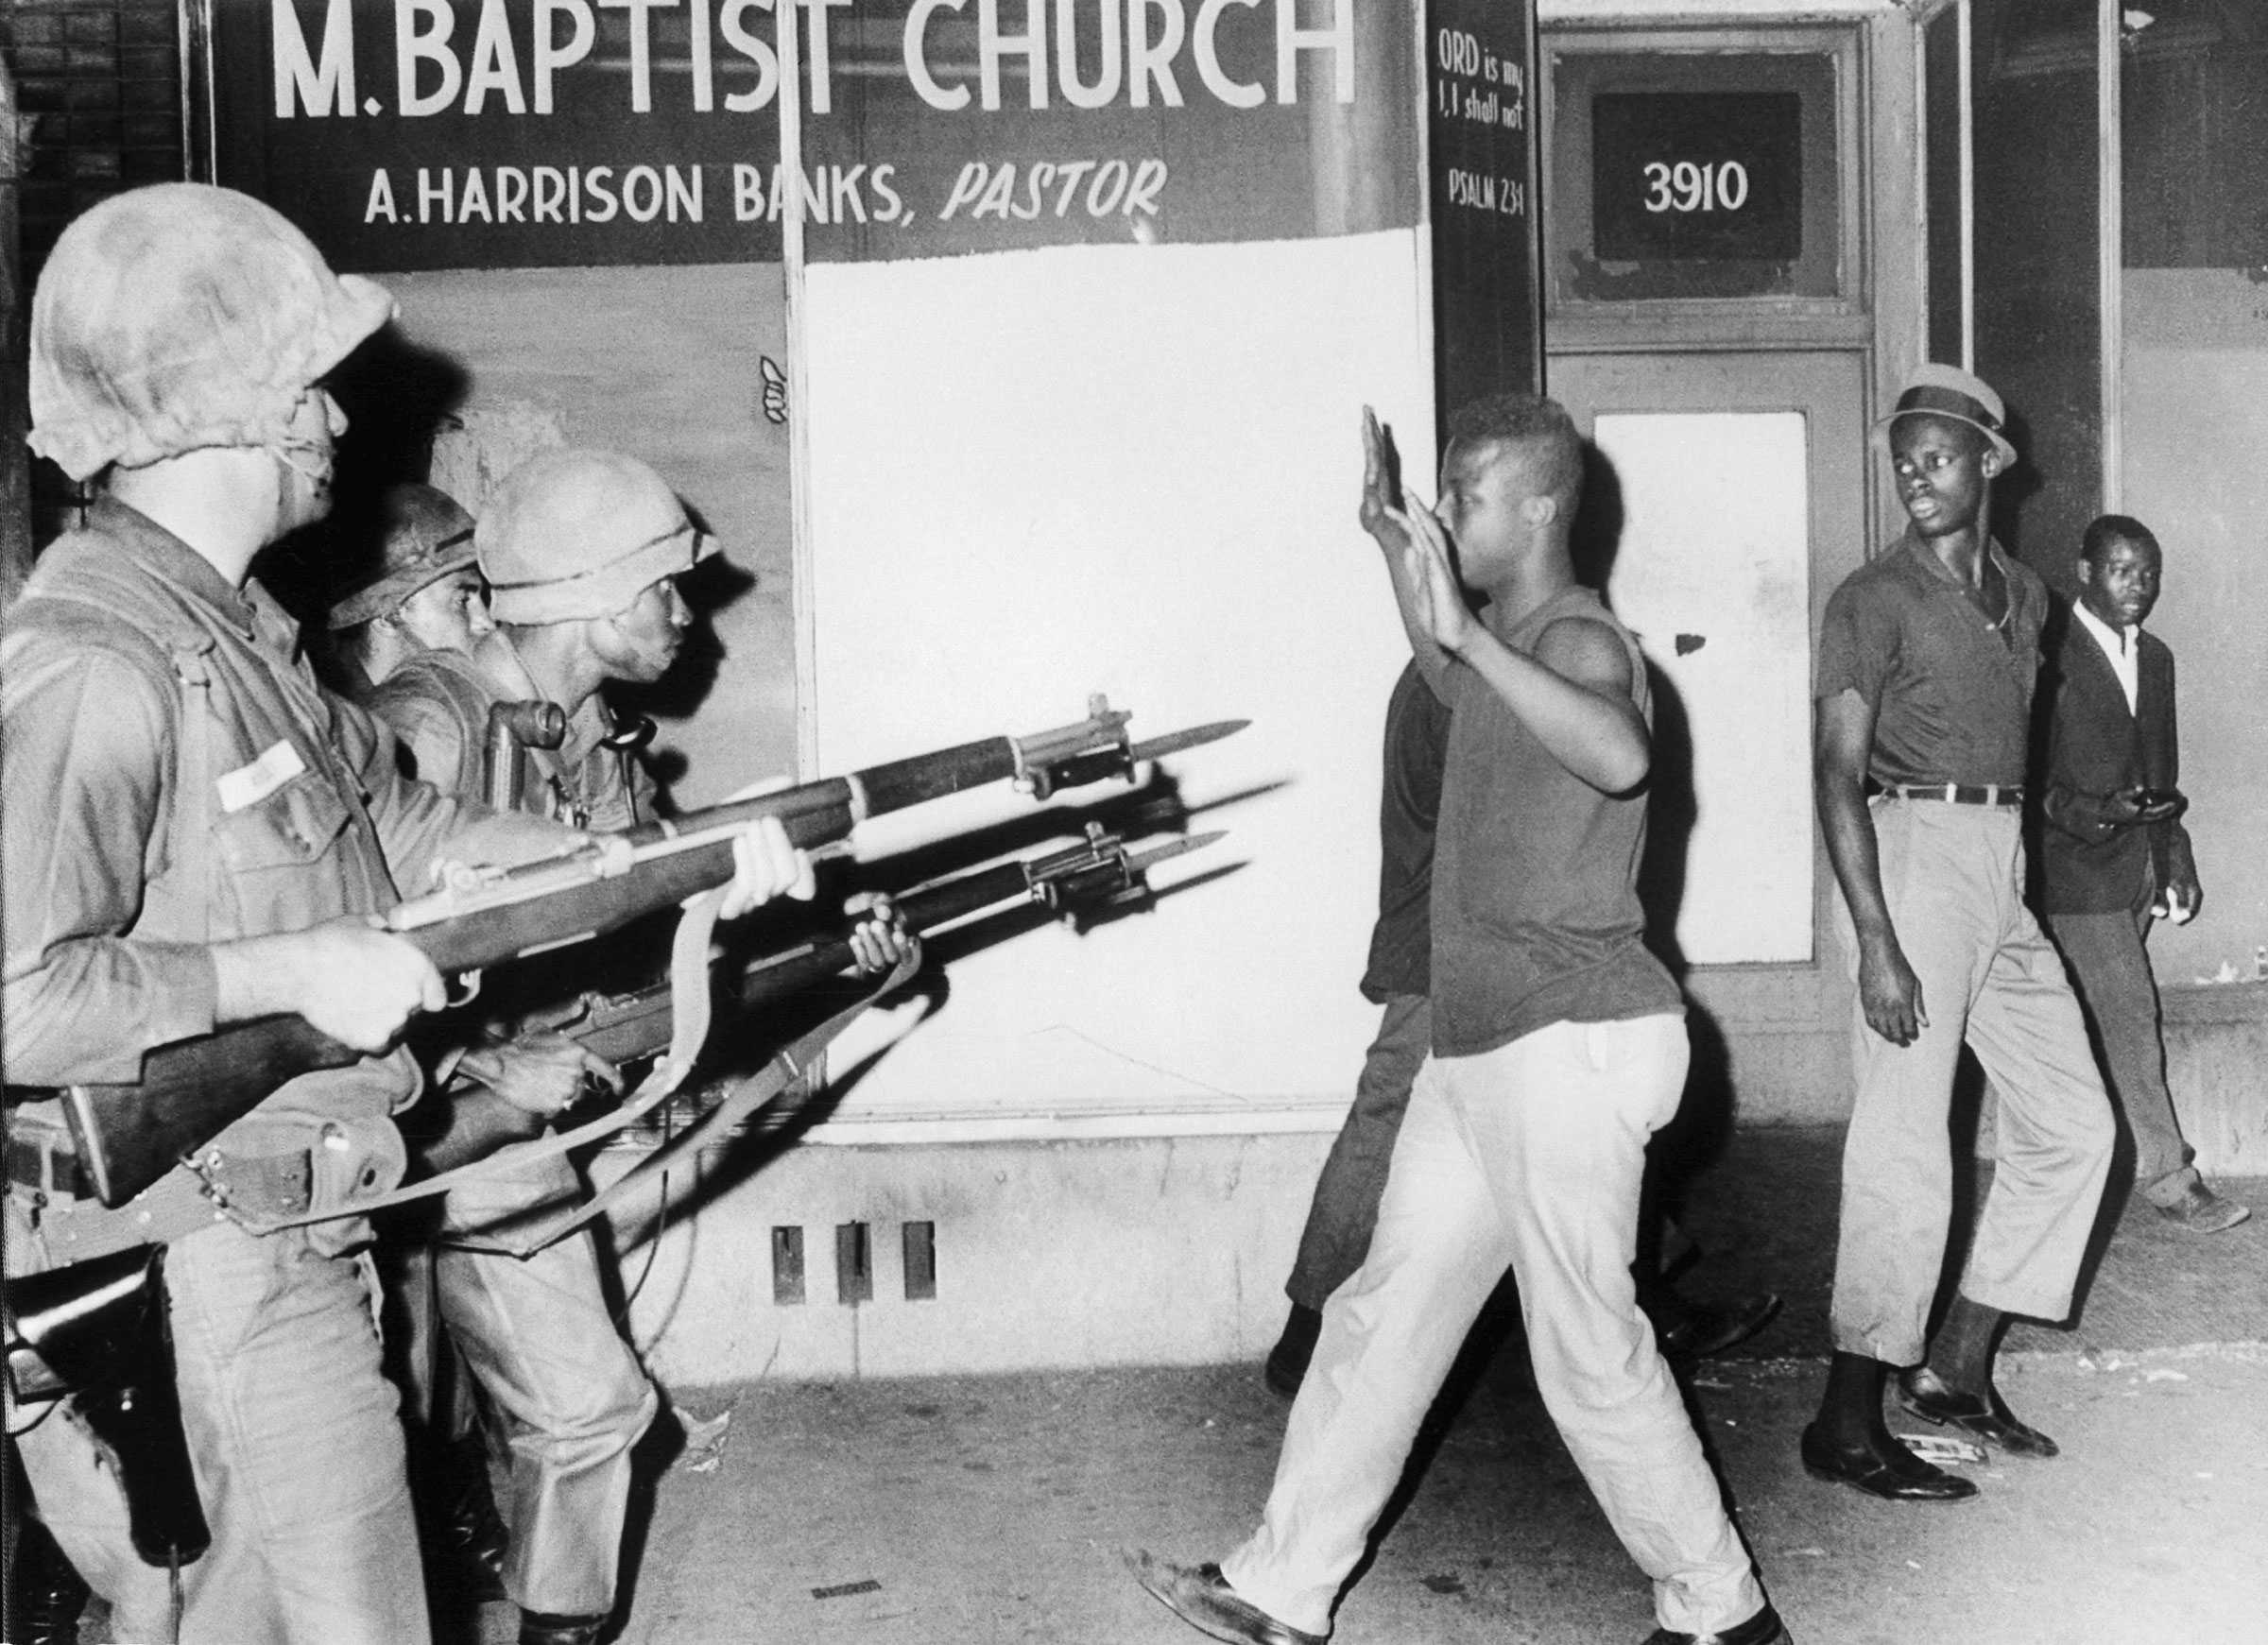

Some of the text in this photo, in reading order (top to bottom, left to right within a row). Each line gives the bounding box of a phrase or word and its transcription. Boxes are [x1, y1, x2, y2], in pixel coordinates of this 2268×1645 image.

[902, 0, 1355, 111] CHURCH
[1437, 27, 1523, 96] ORD is my
[1465, 87, 1499, 124] shall
[1503, 98, 1523, 130] not
[938, 159, 1168, 220] PASTOR
[1449, 168, 1495, 211] PSALM
[1643, 161, 1748, 214] 3910
